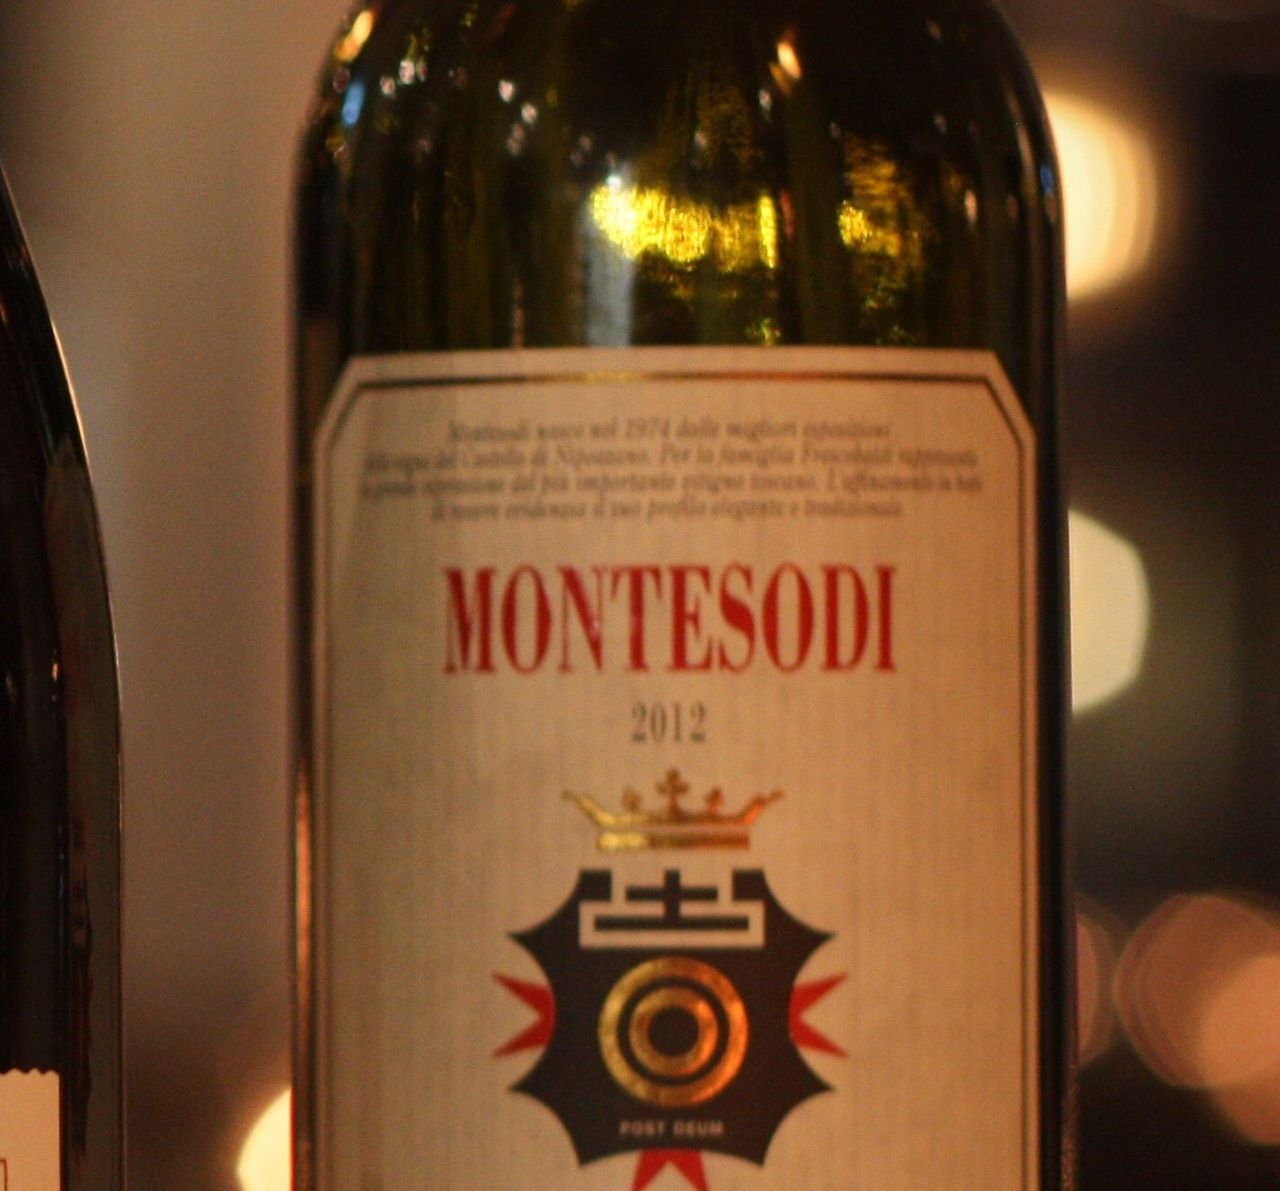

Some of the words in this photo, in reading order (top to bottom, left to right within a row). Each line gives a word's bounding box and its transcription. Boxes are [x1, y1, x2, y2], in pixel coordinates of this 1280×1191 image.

[443, 561, 897, 676] MONTESODI
[630, 703, 708, 745] 2012
[619, 1119, 667, 1138] POST
[672, 1119, 725, 1138] DEUM
